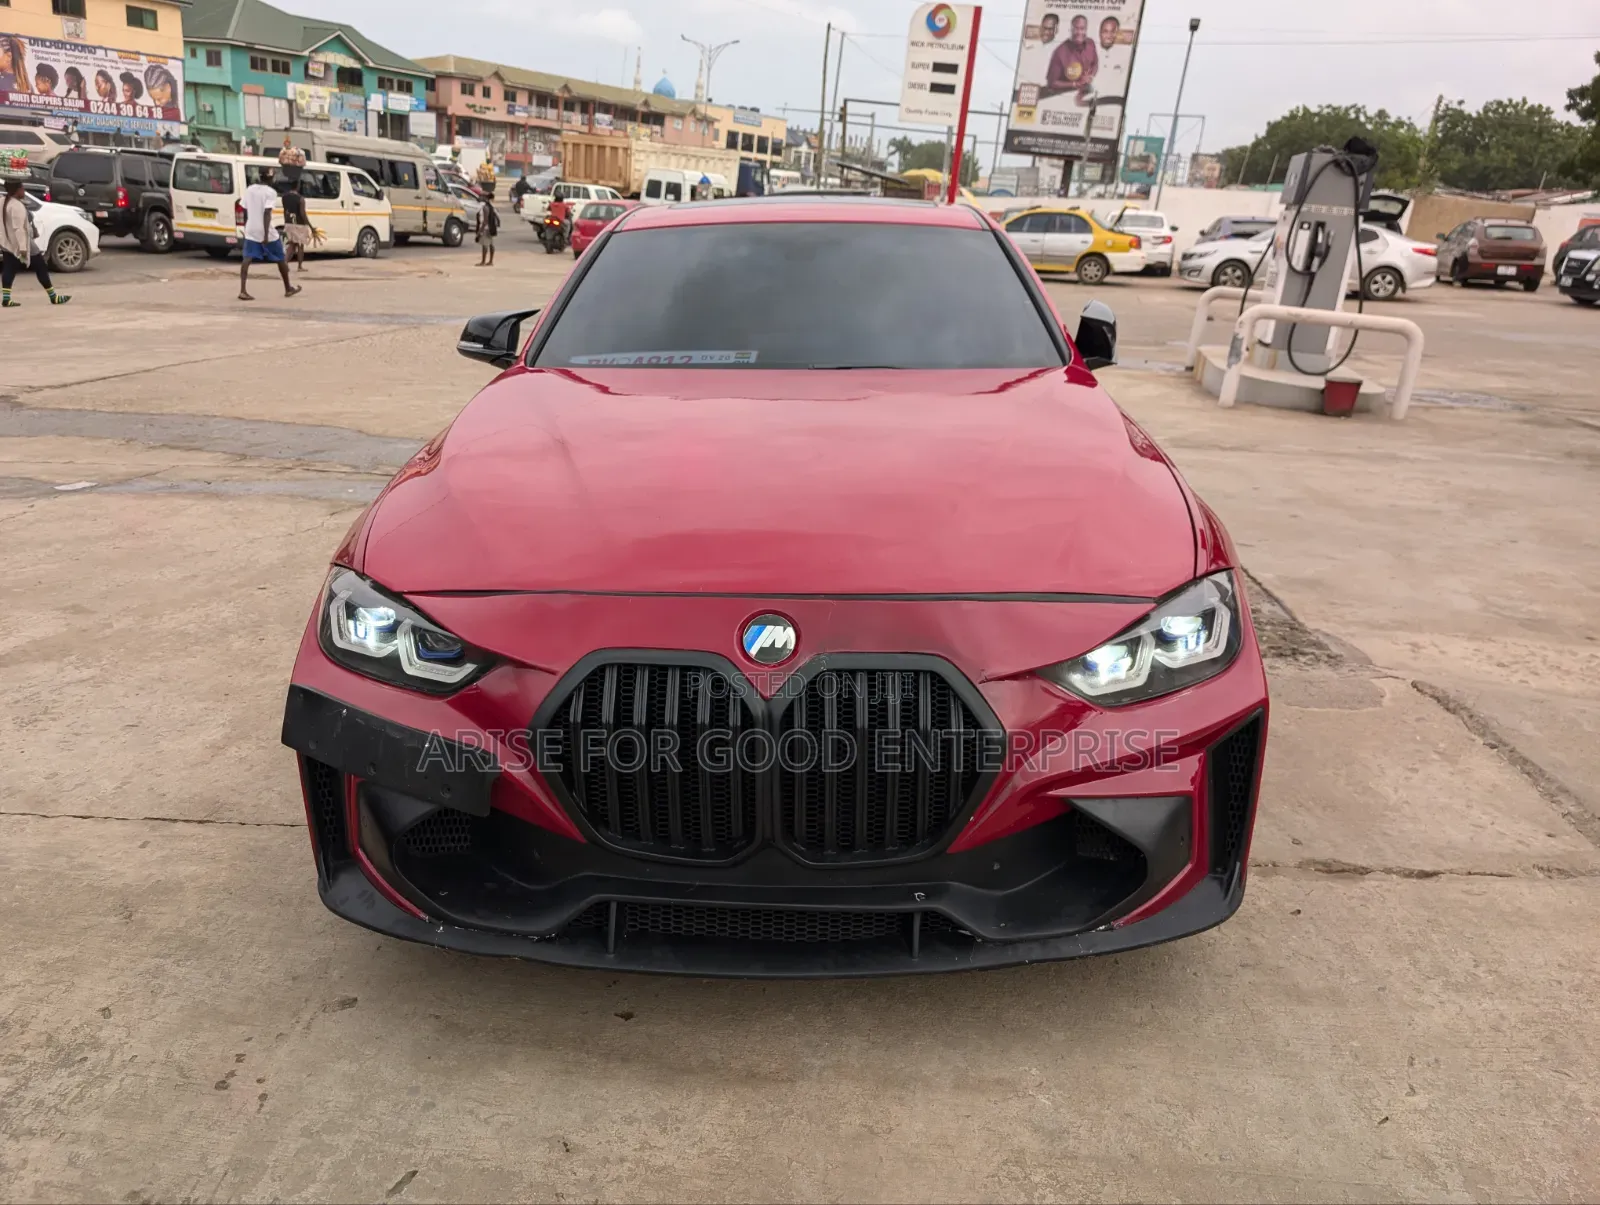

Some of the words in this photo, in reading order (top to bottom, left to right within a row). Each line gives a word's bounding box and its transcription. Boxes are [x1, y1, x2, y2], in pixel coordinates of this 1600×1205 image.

[926, 41, 965, 51] PETROLEUM
[911, 61, 930, 70] SUPER
[907, 82, 928, 91] DIESEL
[8, 92, 30, 103] MULTI
[31, 94, 63, 106] CLIPPERS
[64, 98, 85, 108] SALON
[90, 101, 118, 115] 0244
[120, 104, 133, 117] 30
[136, 106, 149, 118] 64
[152, 107, 163, 119] 18
